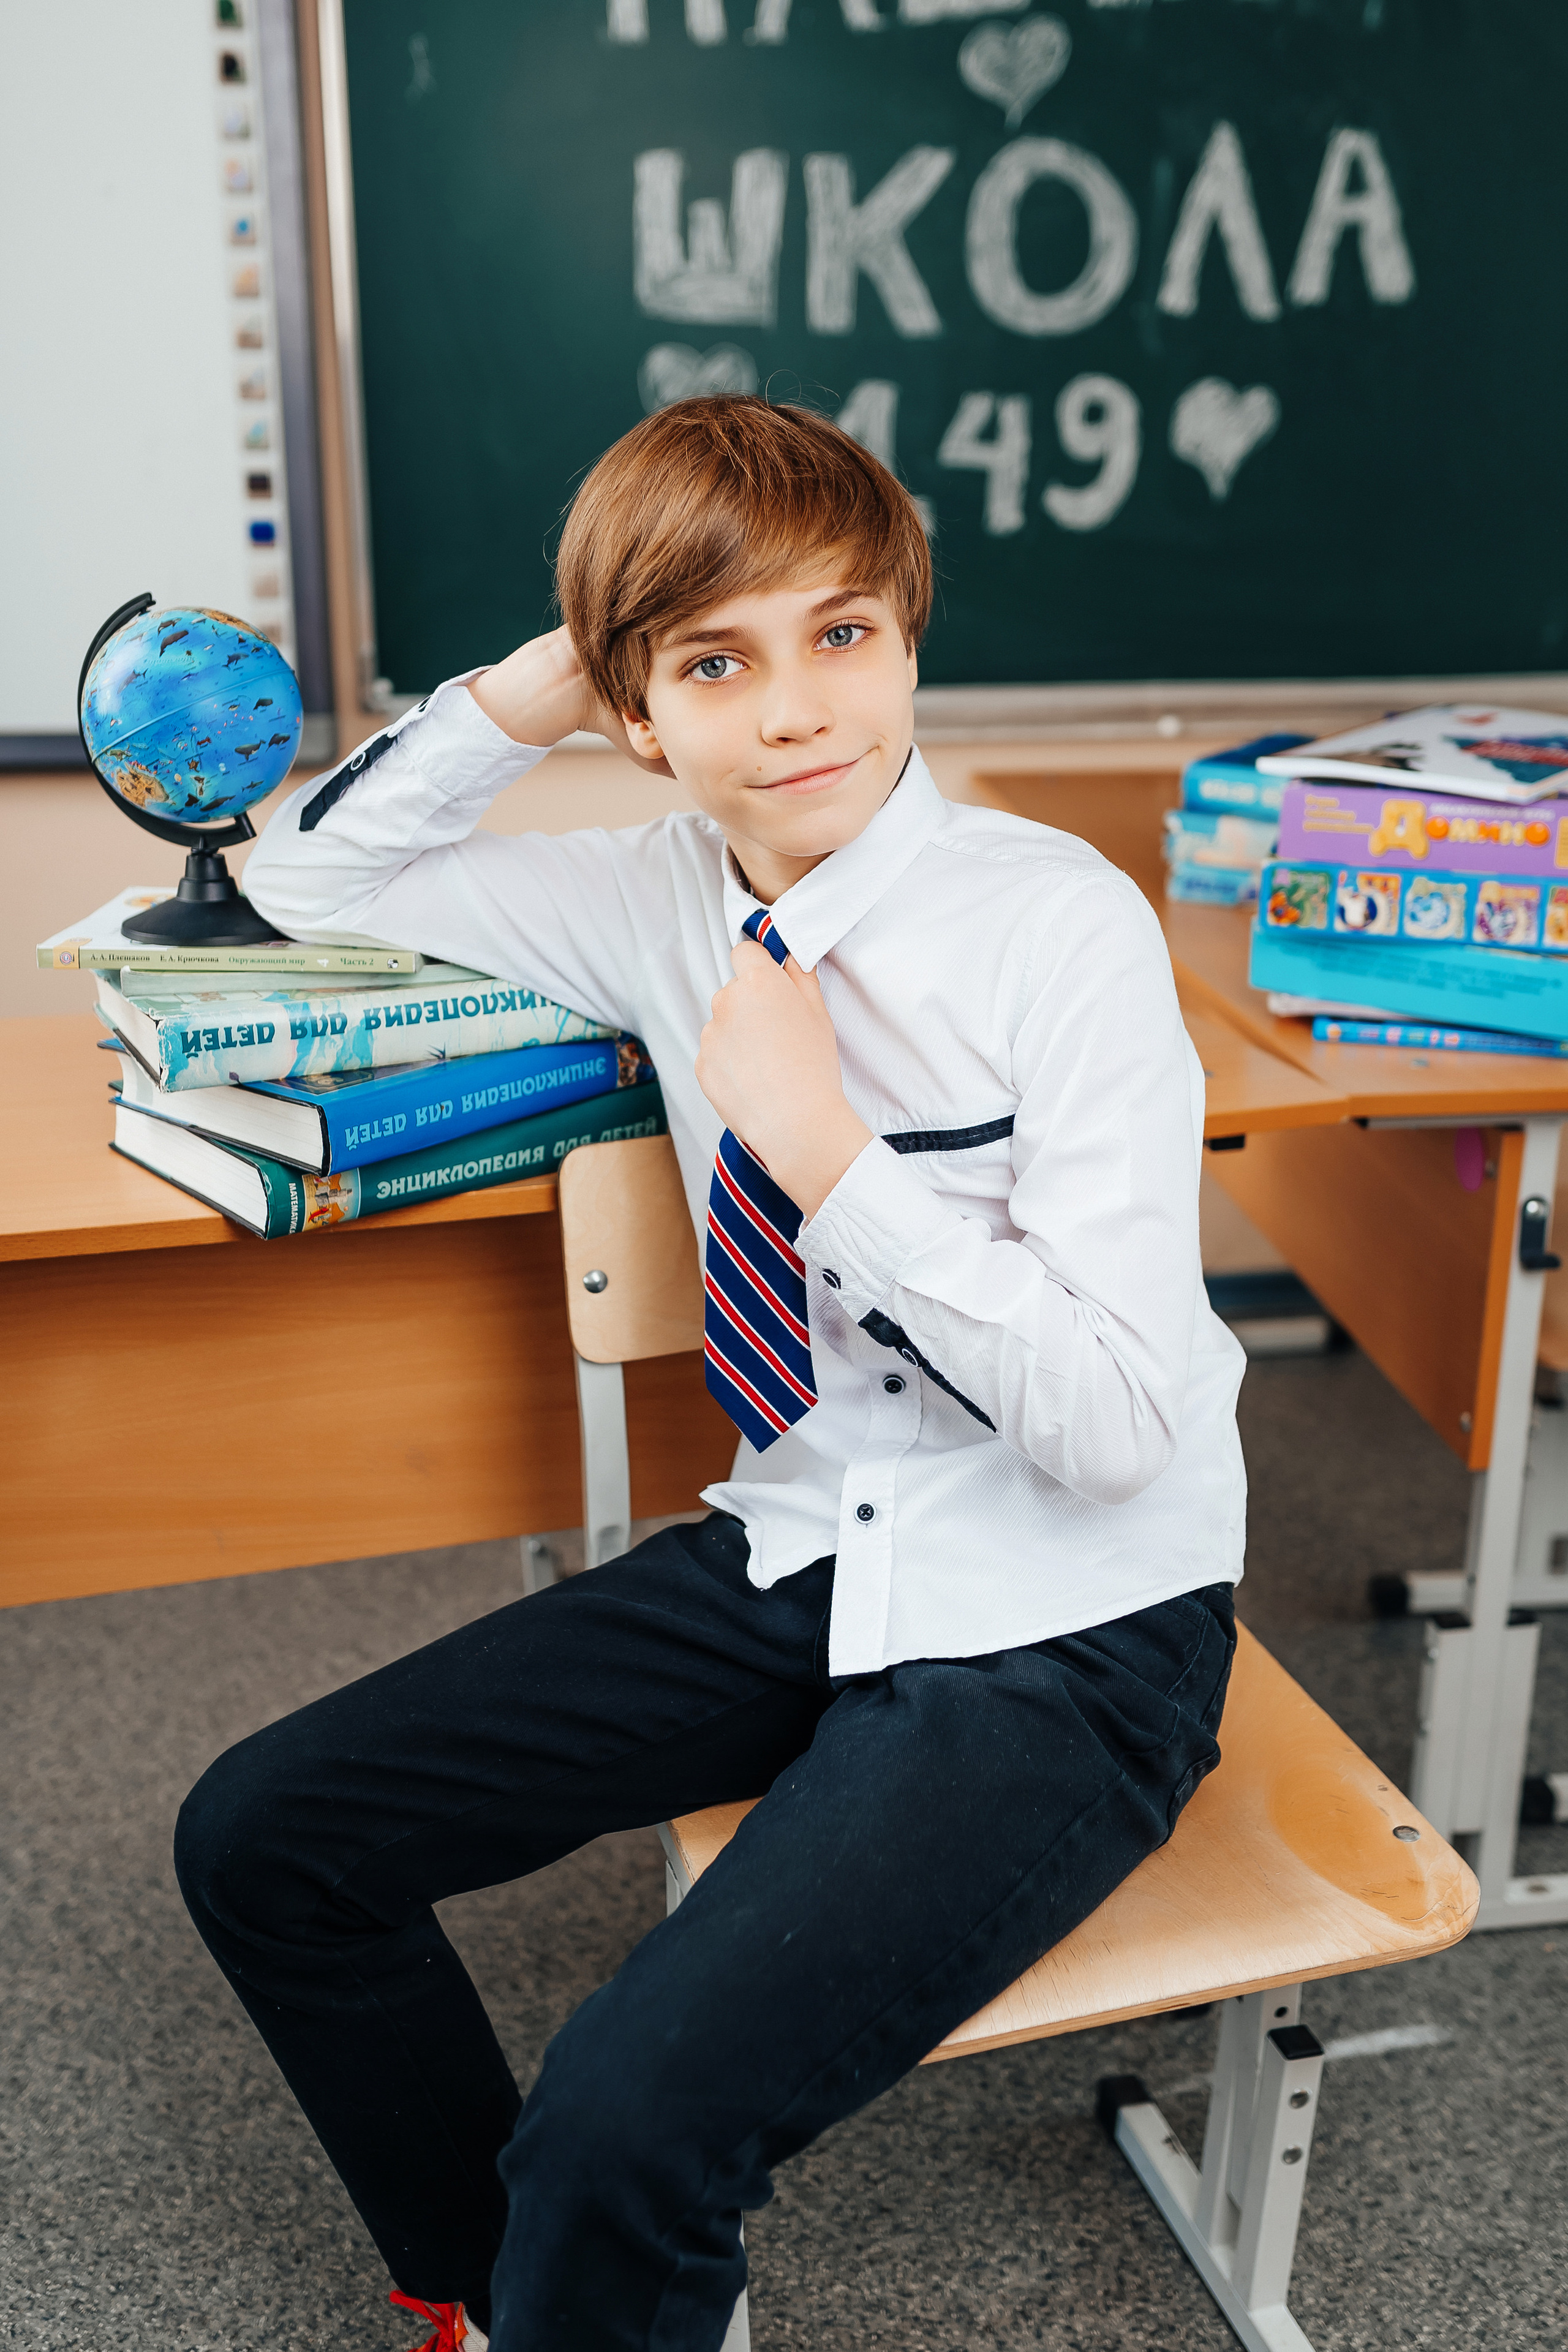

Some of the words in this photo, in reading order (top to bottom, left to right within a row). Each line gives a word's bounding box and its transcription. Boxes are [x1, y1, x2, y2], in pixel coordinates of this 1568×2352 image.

[633, 123, 1415, 337] ШКОЛА
[108, 953, 150, 962] Плешаков
[178, 954, 219, 964] Крючкова
[228, 956, 287, 965] Окружающий
[290, 1013, 348, 1041] ДЛЯ
[363, 989, 558, 1031] ИКЛОПЕДИЯ
[179, 1022, 276, 1058] ДЕТЕЙ
[461, 1056, 607, 1114] ЭНЦИКЛОПЕДИЯ
[345, 1112, 407, 1152] ДЕТЕЙ
[415, 1099, 454, 1127] ДЛЯ
[375, 1144, 545, 1199] ЭНЦИКЛОПЕДИЯ
